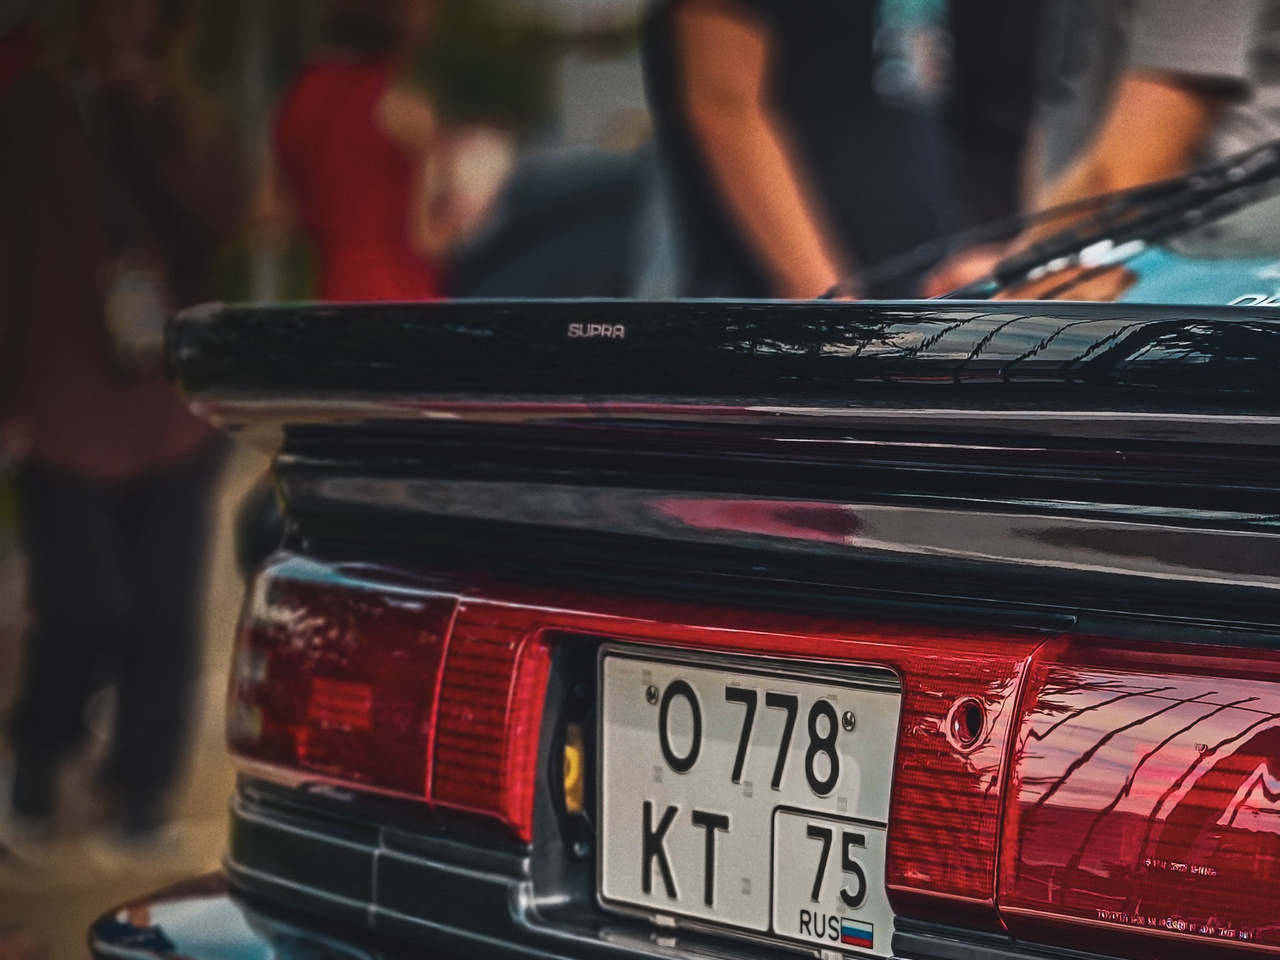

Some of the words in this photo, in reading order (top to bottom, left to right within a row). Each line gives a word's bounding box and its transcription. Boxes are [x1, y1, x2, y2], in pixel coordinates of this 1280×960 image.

[568, 323, 625, 339] SUPRA
[659, 679, 702, 774] O
[725, 685, 841, 798] 778
[641, 800, 730, 908] KT
[806, 823, 868, 911] 75
[799, 909, 841, 943] RUS
